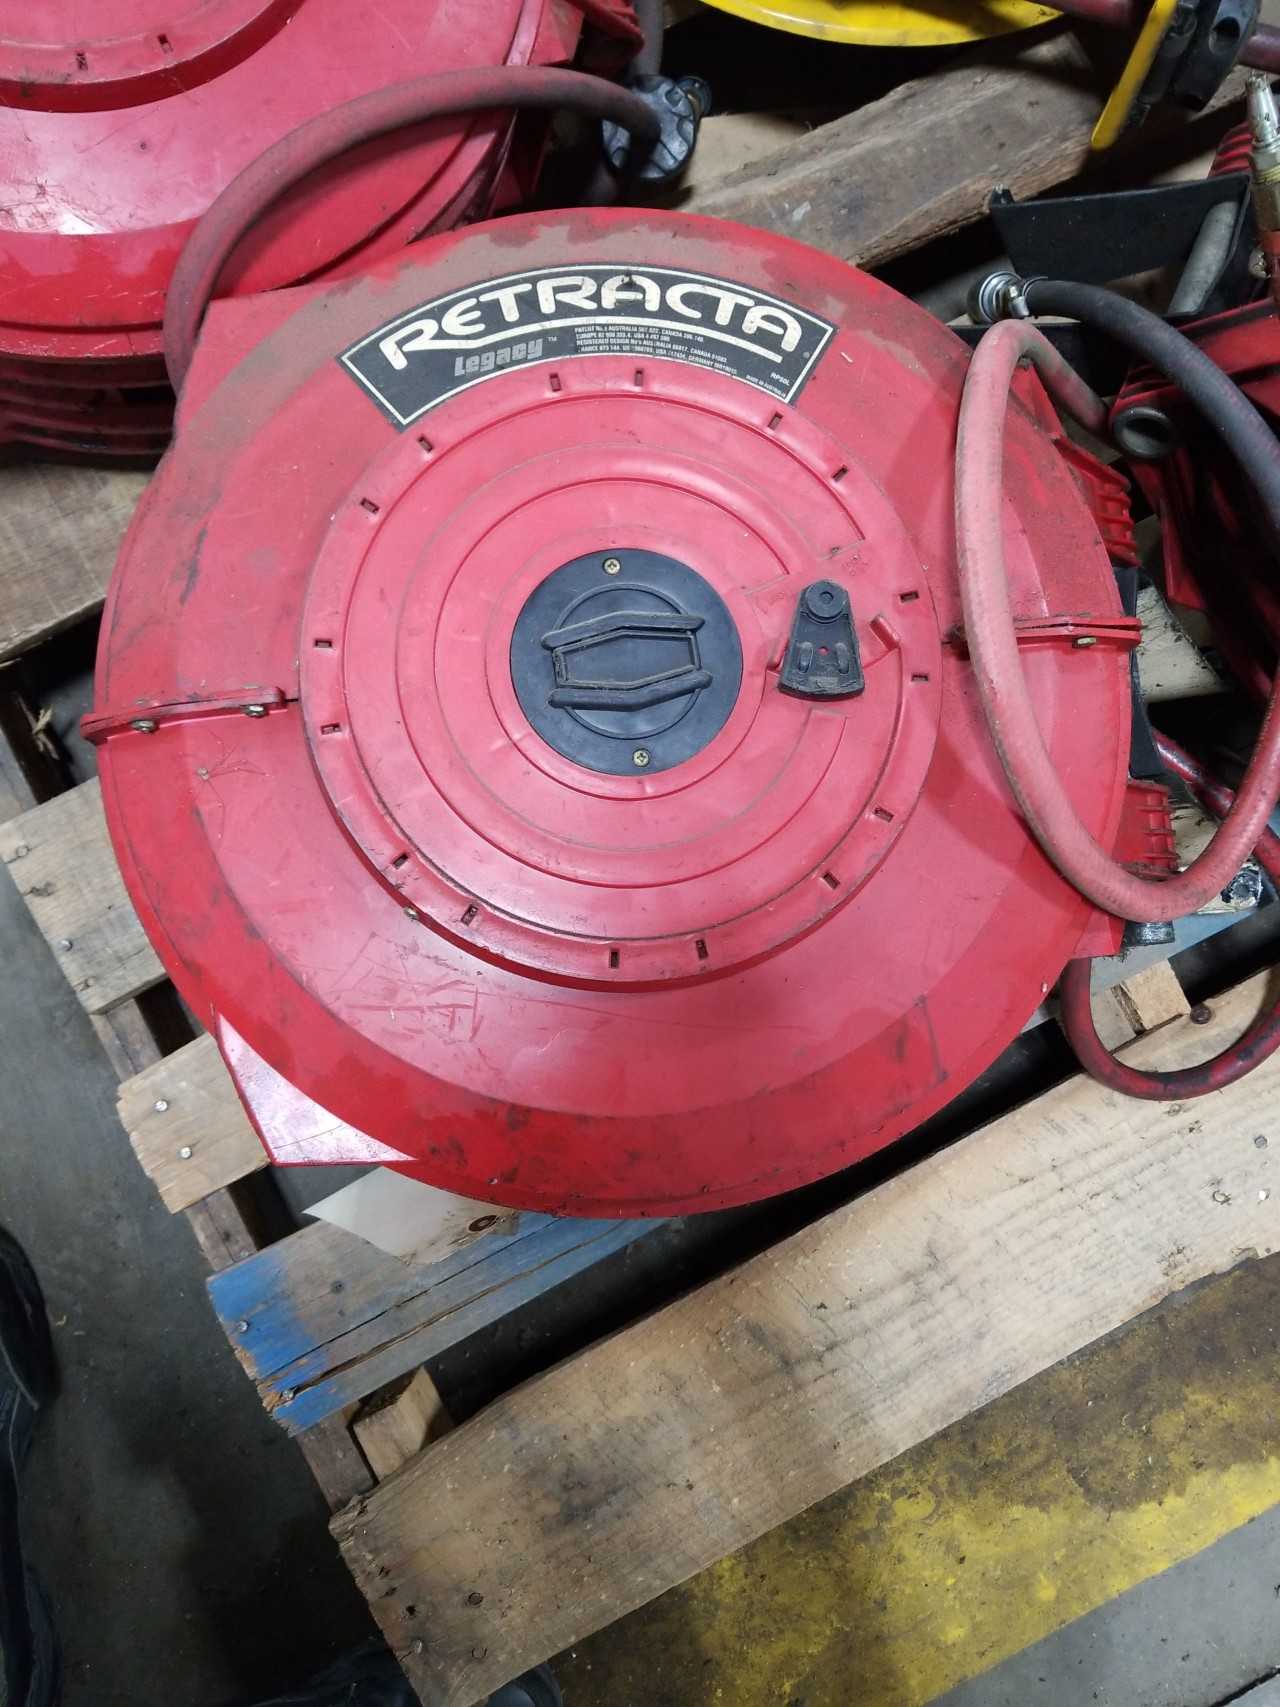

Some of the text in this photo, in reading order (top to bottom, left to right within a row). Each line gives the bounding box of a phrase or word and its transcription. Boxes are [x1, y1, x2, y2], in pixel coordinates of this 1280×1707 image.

[379, 274, 803, 370] RETRACTA
[454, 339, 543, 376] Legacy
[576, 338, 609, 346] REGISTERED
